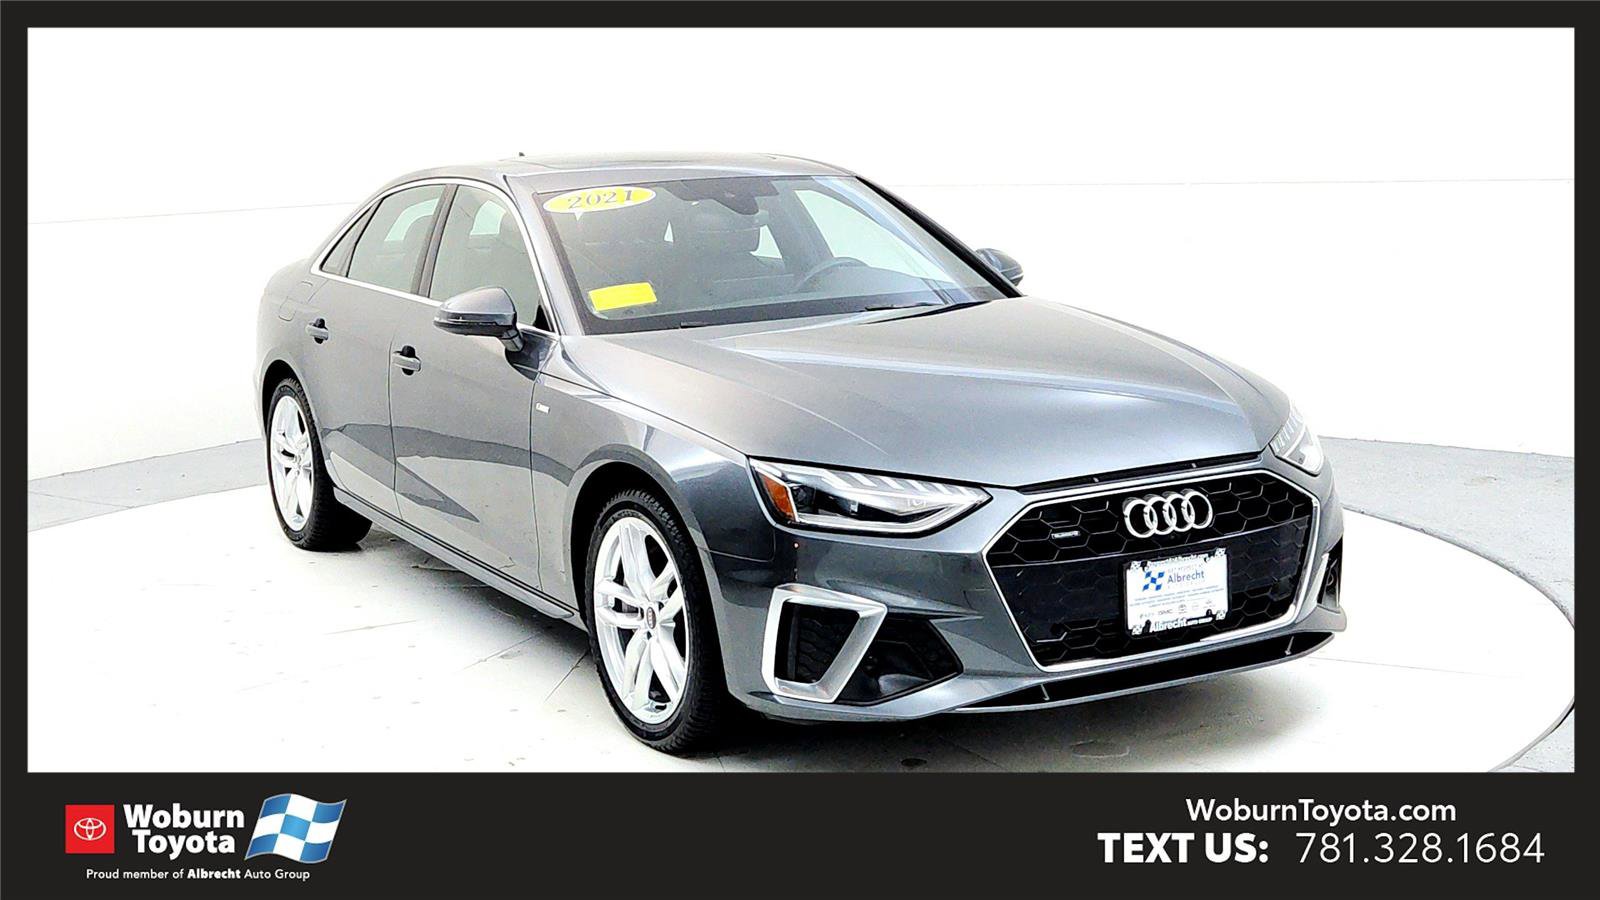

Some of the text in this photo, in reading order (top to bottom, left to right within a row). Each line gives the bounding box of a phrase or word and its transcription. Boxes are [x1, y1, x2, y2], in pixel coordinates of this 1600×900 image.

[567, 190, 632, 209] 2021
[1167, 570, 1205, 584] Albrecht
[1149, 617, 1187, 633] Albrecht
